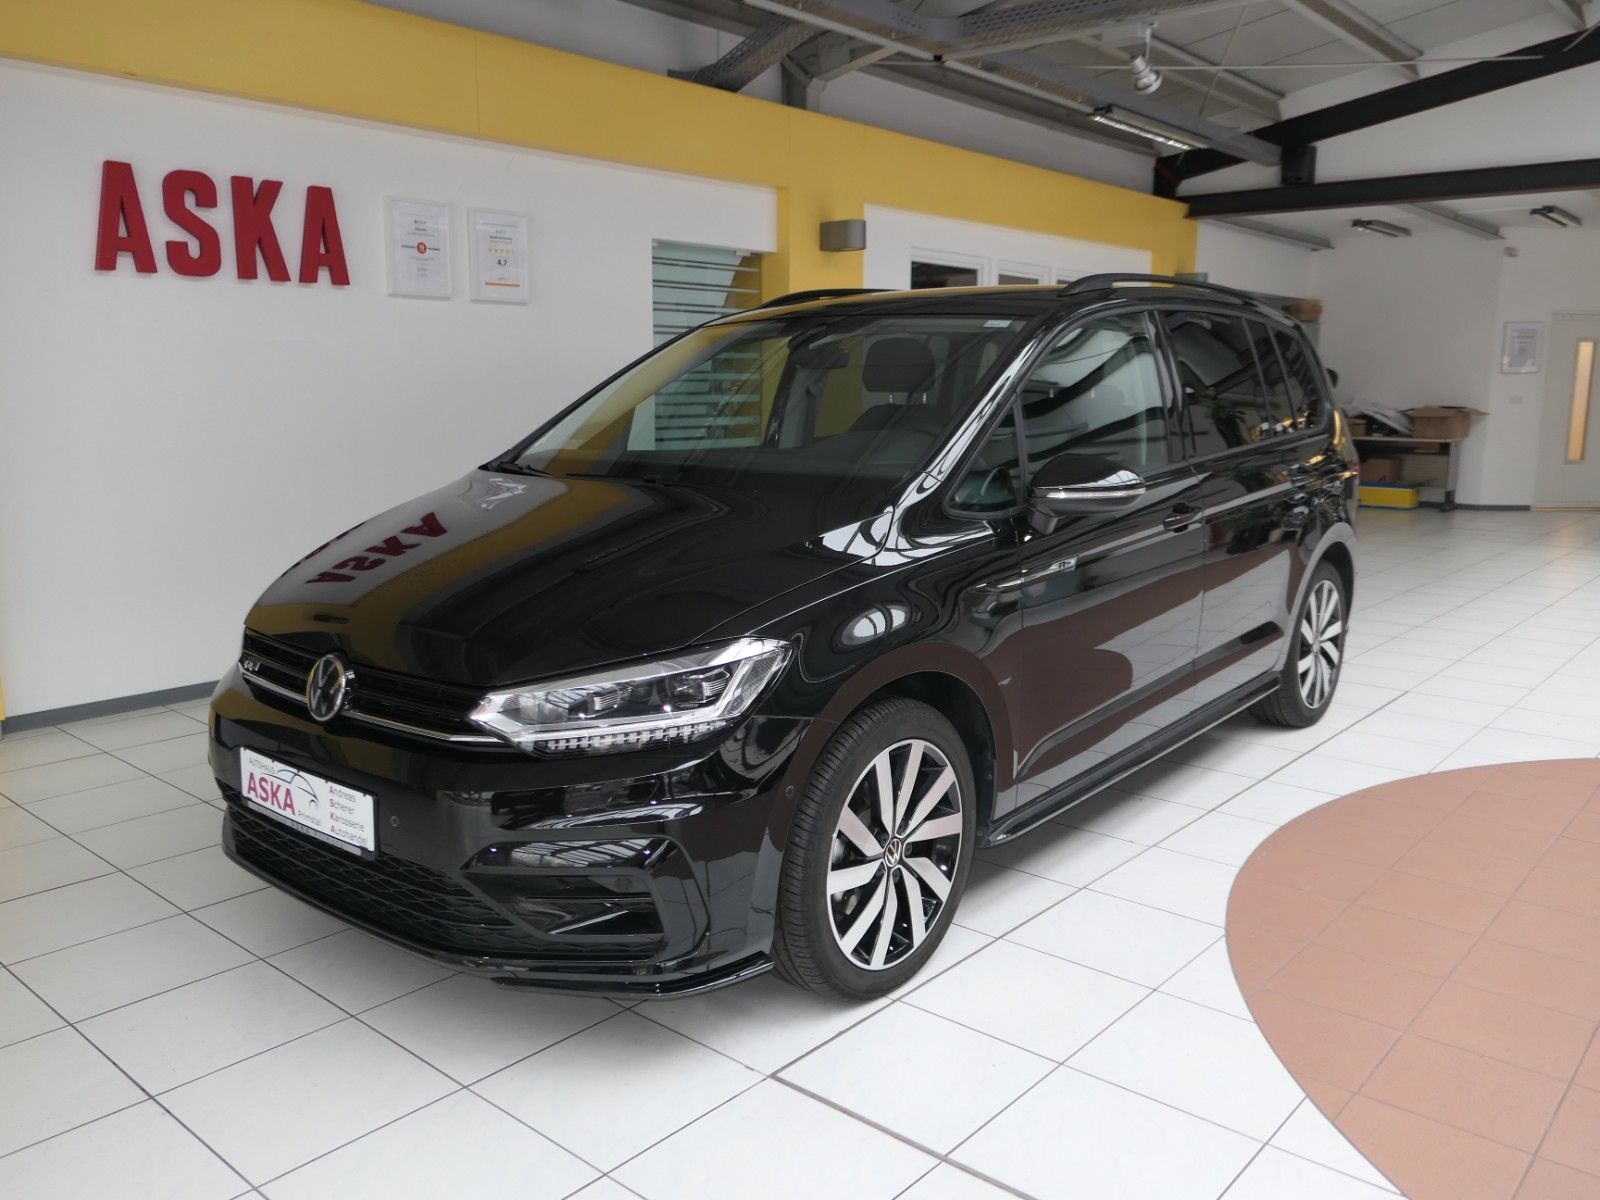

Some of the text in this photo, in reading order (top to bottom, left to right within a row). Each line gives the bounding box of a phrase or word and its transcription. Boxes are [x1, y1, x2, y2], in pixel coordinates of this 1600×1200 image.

[95, 160, 350, 285] ASKA
[247, 772, 296, 816] ASKA
[329, 786, 357, 803] Andreas
[329, 798, 355, 815] Scherer
[330, 812, 365, 833] Karosserie
[330, 825, 368, 846] Autohandel
